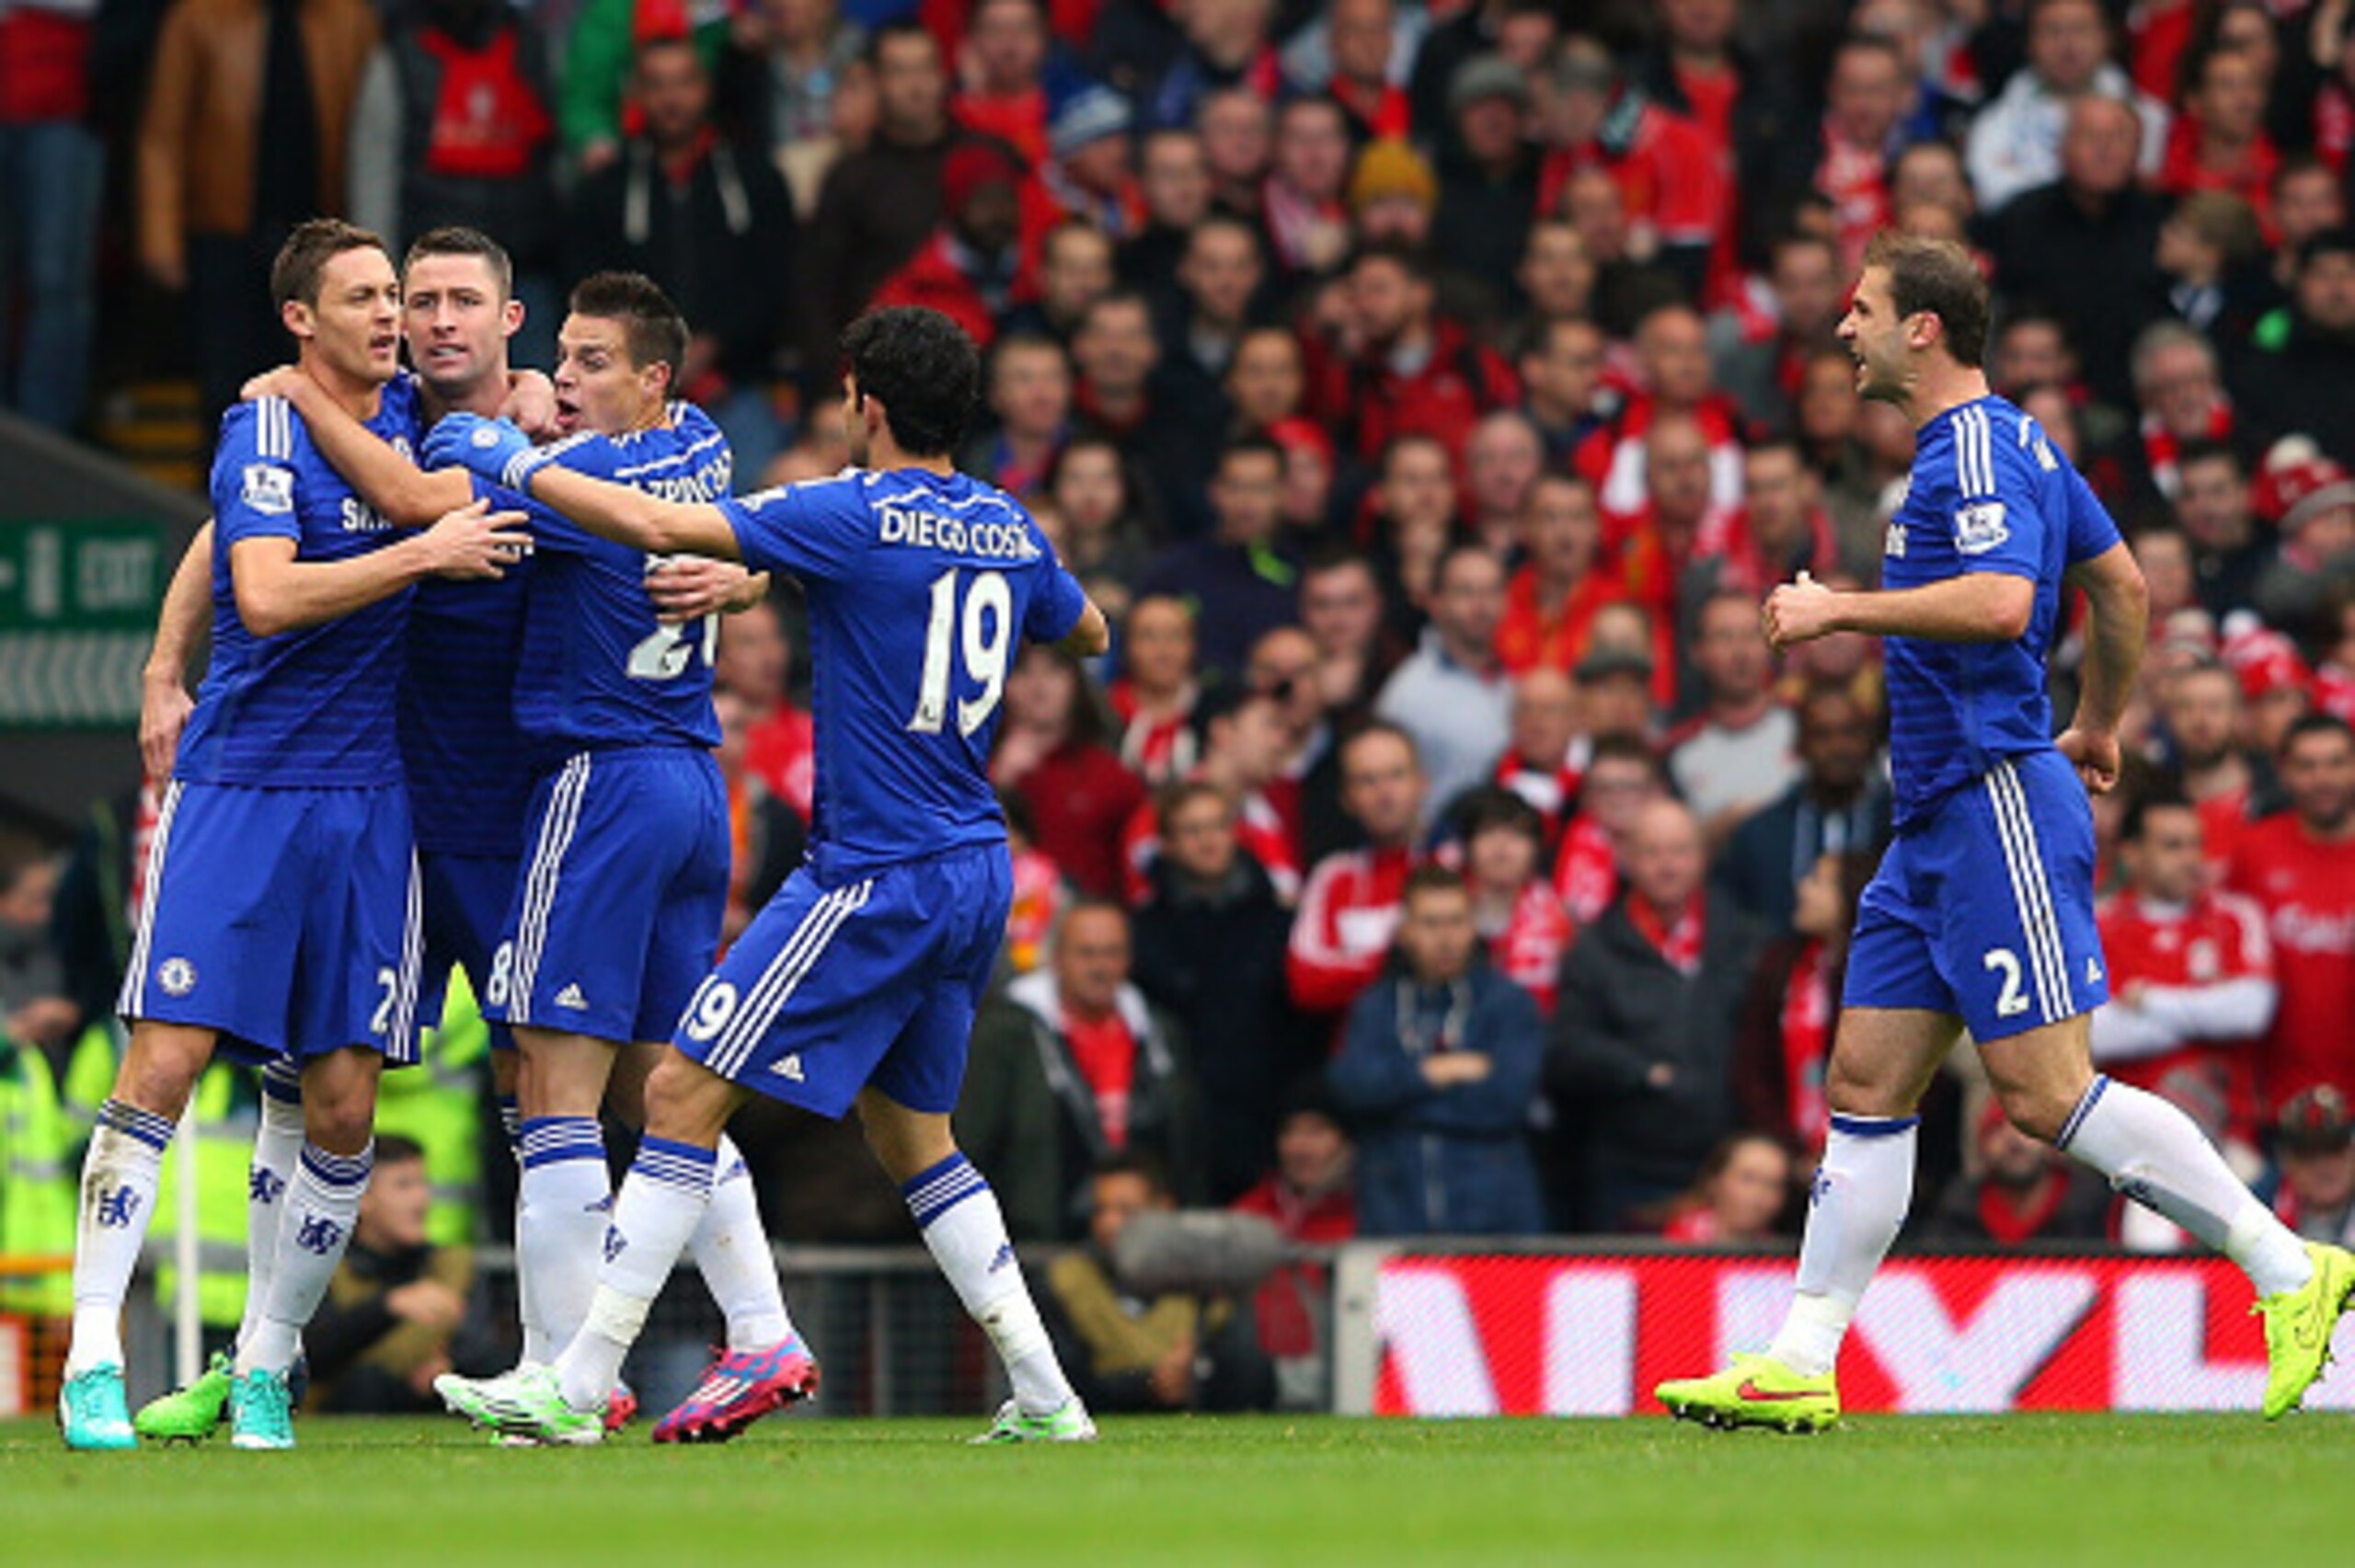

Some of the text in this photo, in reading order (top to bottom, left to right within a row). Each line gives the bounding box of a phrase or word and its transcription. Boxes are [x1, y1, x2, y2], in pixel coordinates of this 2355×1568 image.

[879, 506, 967, 554] DIEGO
[906, 567, 1012, 739] 19
[1983, 947, 2030, 1018] 2
